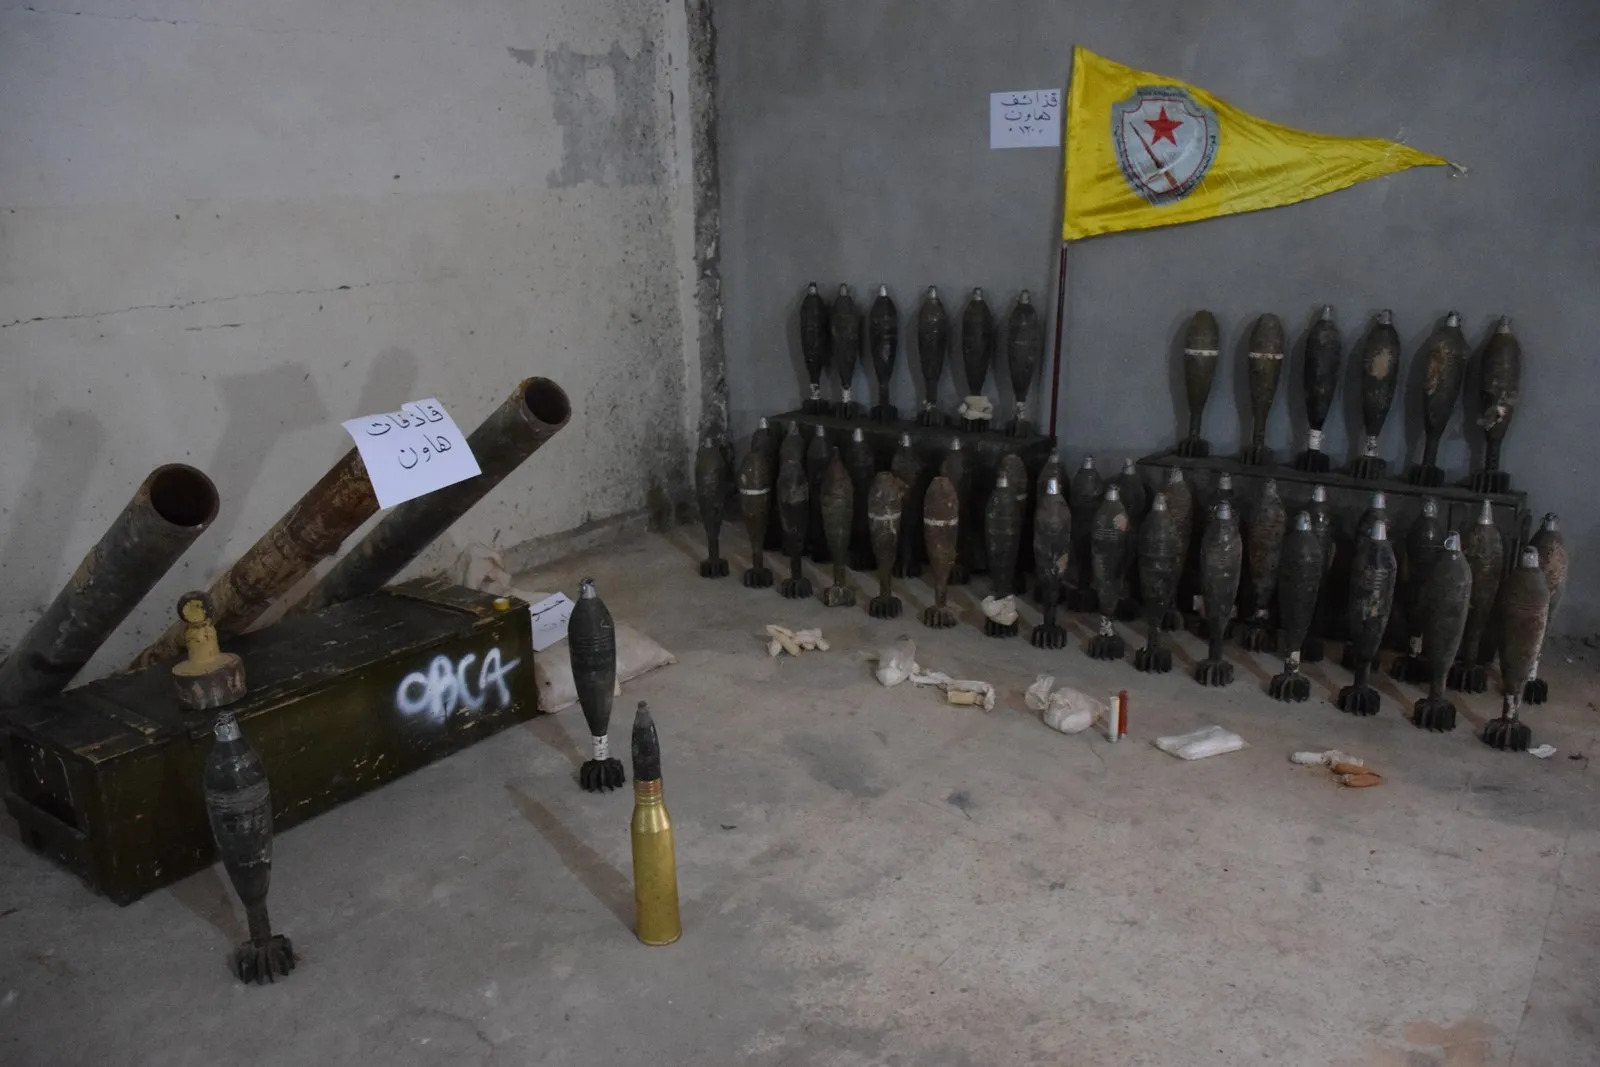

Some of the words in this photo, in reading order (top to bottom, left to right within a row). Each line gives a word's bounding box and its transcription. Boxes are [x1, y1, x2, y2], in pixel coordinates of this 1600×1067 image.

[1003, 108, 1051, 122] هاون
[366, 404, 445, 436] قاذفات
[397, 433, 452, 470] هاون
